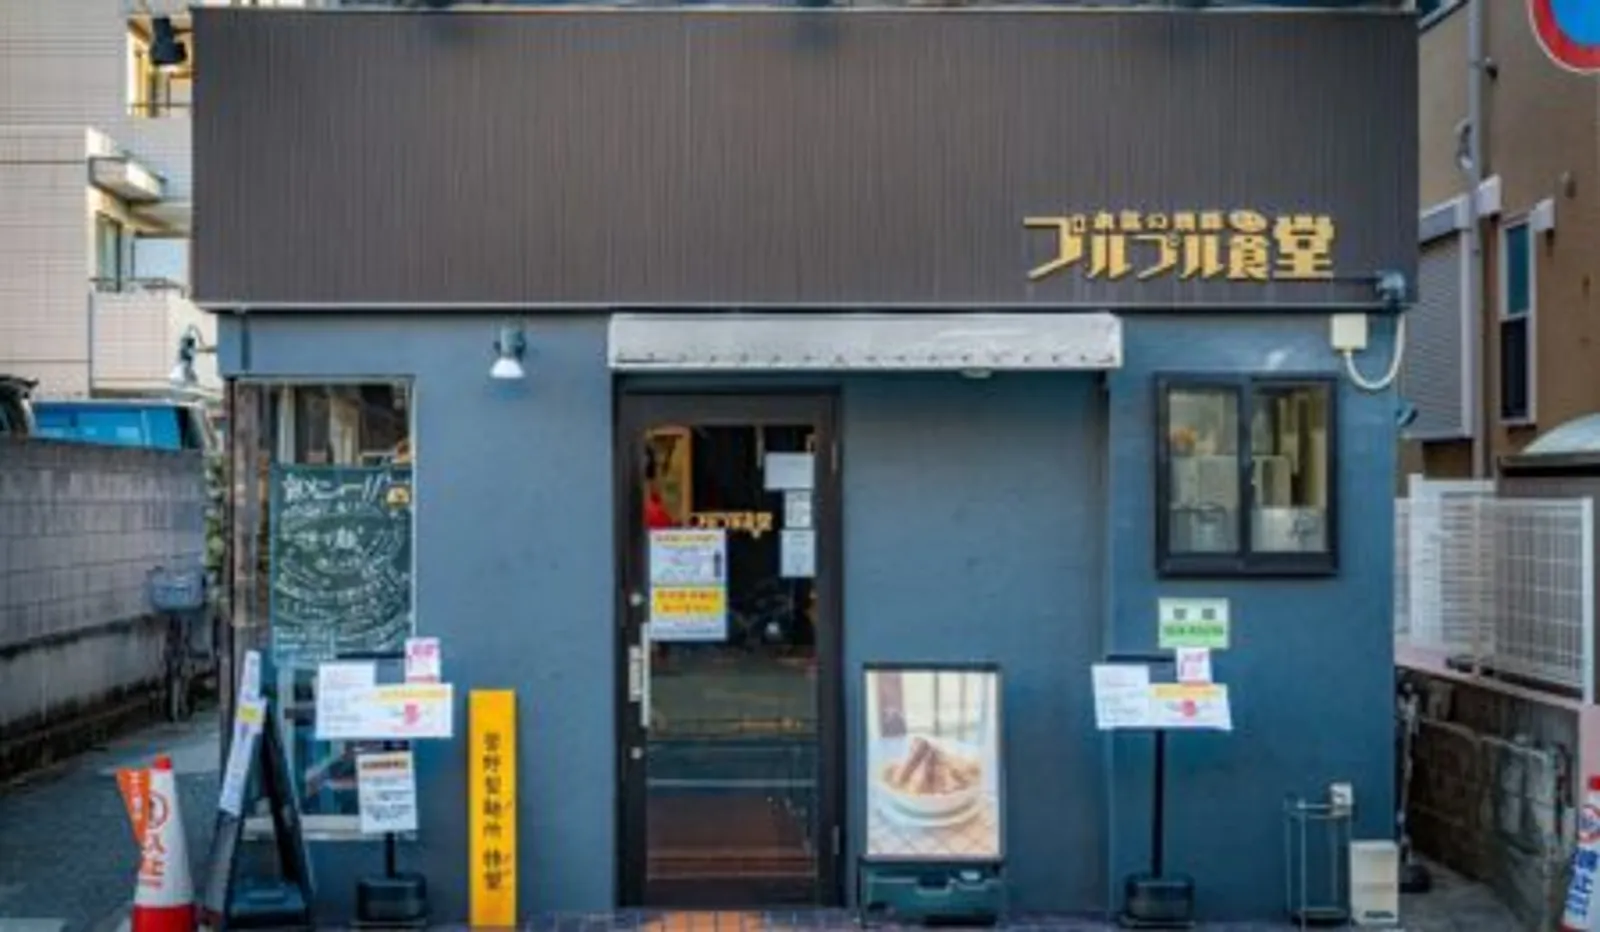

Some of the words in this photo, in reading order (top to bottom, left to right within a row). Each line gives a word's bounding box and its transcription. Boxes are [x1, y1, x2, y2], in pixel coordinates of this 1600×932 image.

[1023, 213, 1335, 280] プルプル食堂
